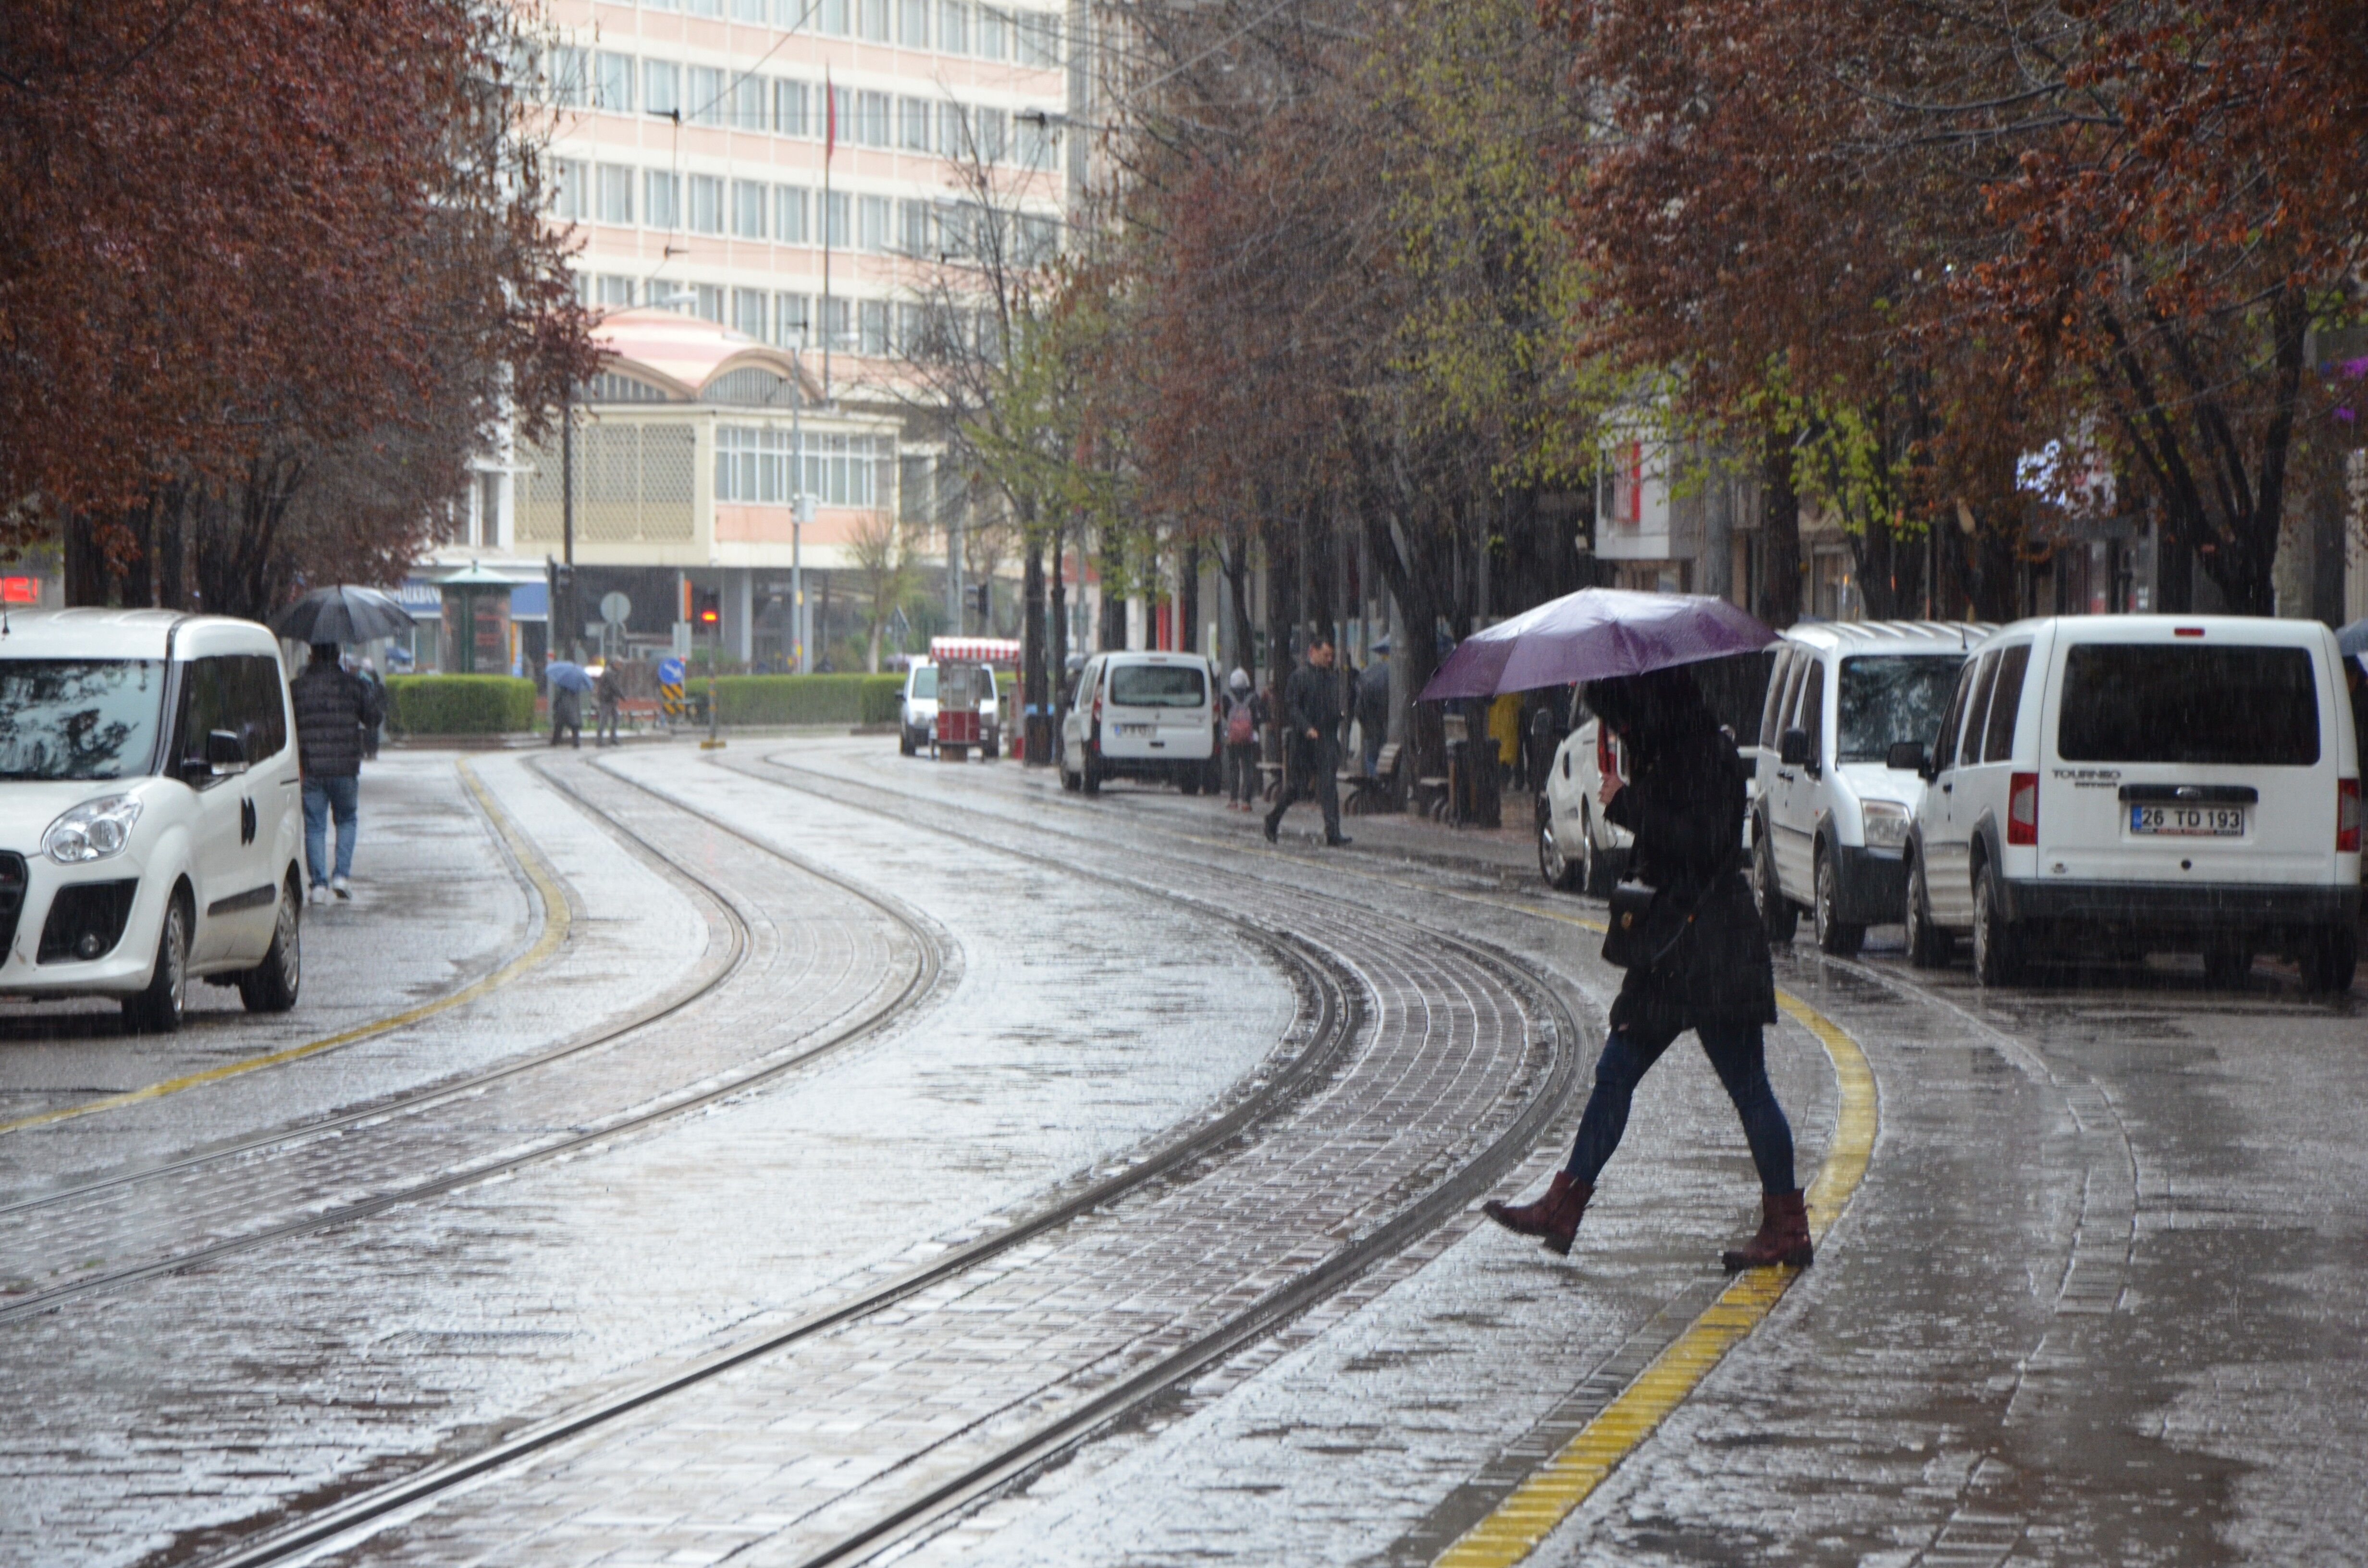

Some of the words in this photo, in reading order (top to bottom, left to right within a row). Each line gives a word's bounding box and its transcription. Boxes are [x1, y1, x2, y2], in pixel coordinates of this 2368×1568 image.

[2142, 809, 2164, 827] 26
[2175, 810, 2201, 827] TD
[2208, 811, 2240, 829] 193
